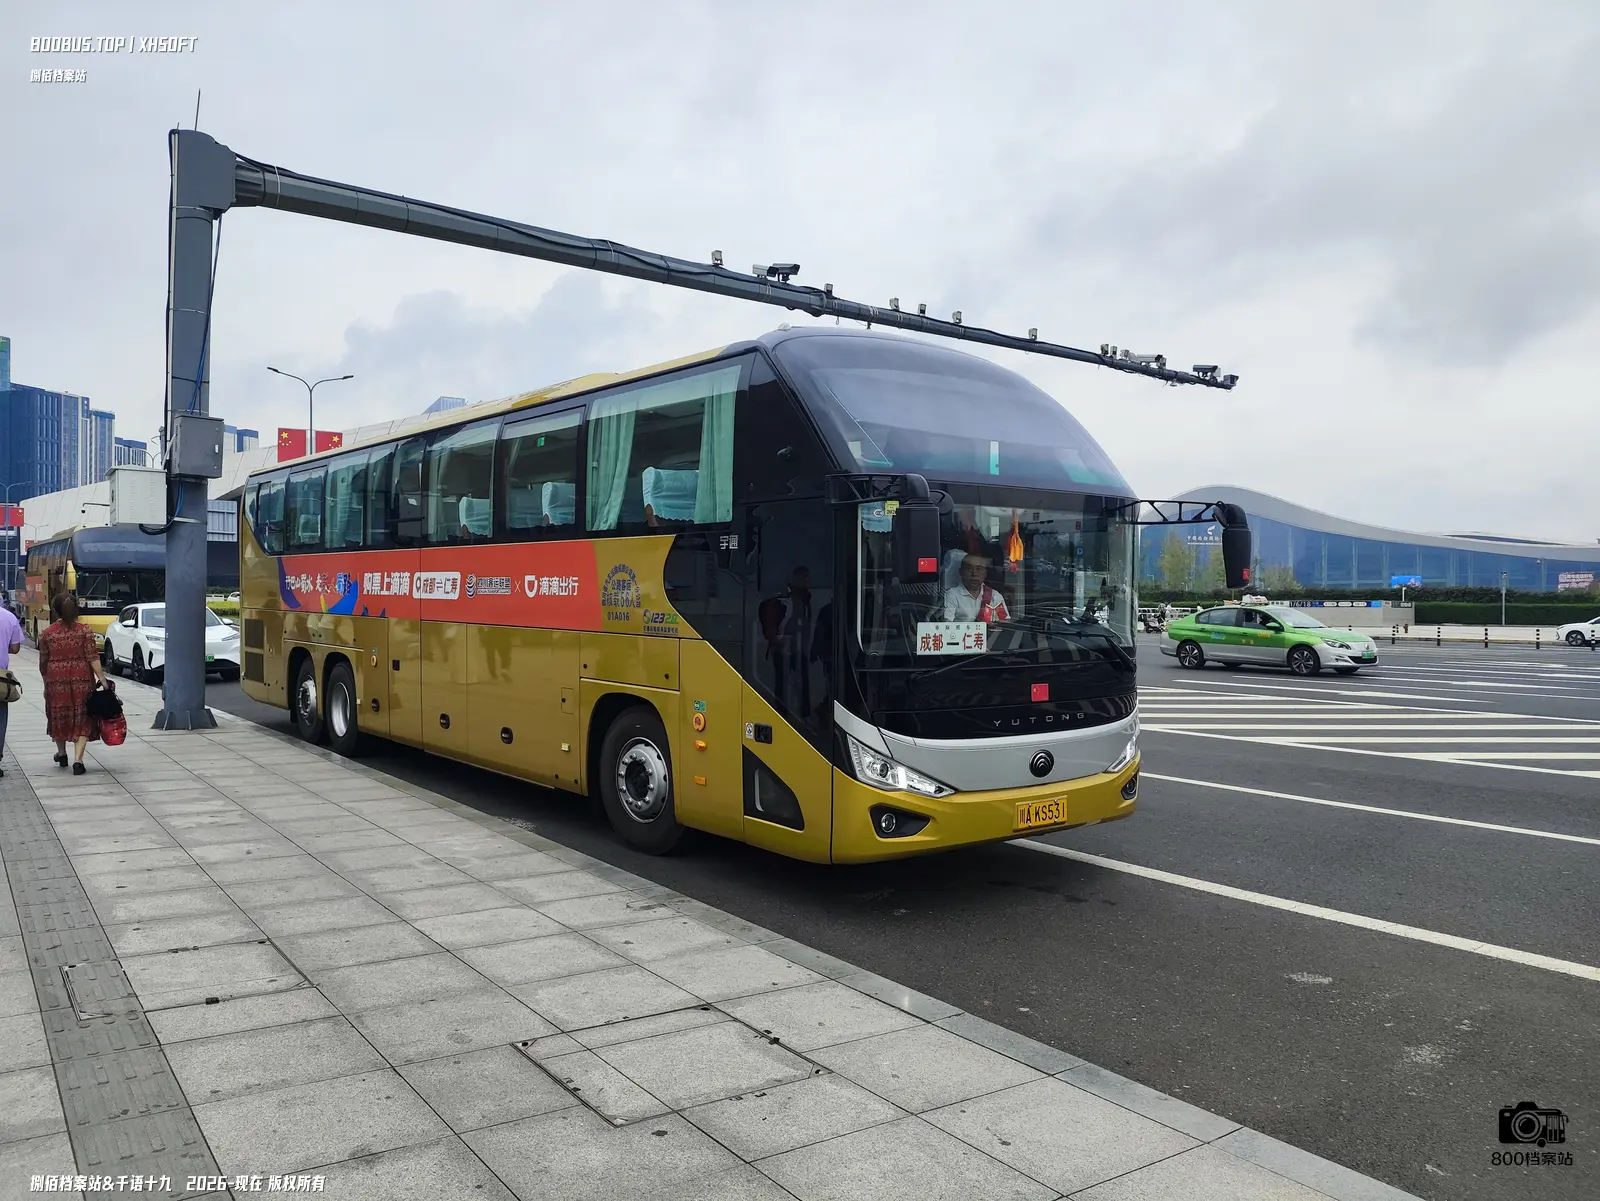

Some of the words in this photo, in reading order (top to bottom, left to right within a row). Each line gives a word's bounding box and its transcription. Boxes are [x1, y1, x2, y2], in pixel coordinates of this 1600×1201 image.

[719, 535, 739, 550] 宇通
[362, 572, 411, 596] 购票上滴滴
[422, 577, 435, 595] 成都
[443, 577, 459, 596] 仁寿
[539, 576, 579, 597] 滴滴出行
[993, 712, 1085, 727] YUTONG
